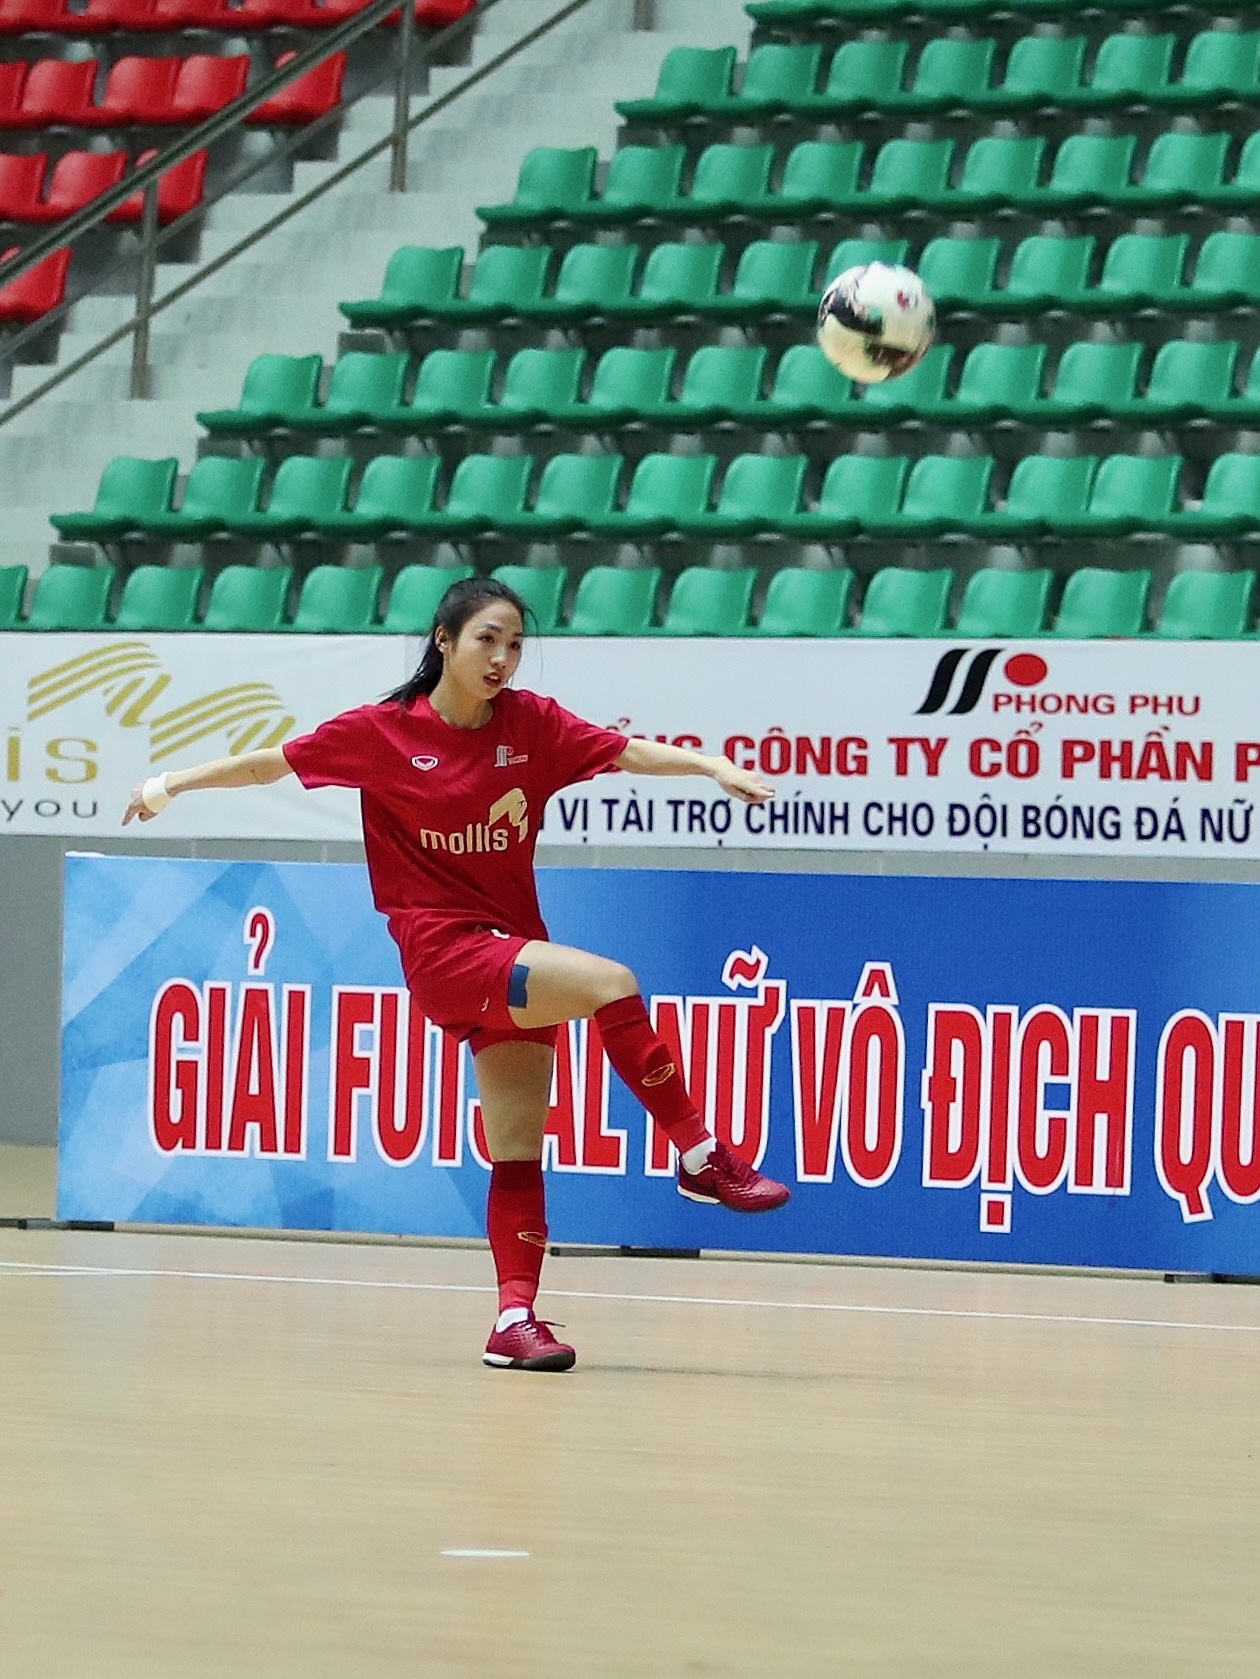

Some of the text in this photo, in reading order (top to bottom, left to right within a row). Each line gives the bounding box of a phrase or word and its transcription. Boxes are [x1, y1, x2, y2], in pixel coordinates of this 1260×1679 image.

[992, 693, 1201, 716] PHONG PHU
[724, 726, 869, 777] CÔNG
[888, 736, 949, 777] TY
[968, 721, 1041, 779] CỔ
[1061, 725, 1214, 782] PHẦN
[1, 798, 98, 822] you
[558, 797, 589, 844] VỊ
[601, 788, 654, 833] TÀI
[666, 797, 733, 847] TRỢ
[744, 790, 850, 836] CHÍNH
[863, 801, 934, 838] CHO
[947, 793, 1008, 850] ĐỘI
[1021, 795, 1121, 841] BÓNG
[1135, 794, 1187, 842] ĐÁ
[1200, 797, 1254, 843] NỮ
[420, 822, 509, 855] mollis
[147, 906, 312, 1161] GIẢI
[327, 984, 628, 1177] FUTAL
[790, 961, 906, 1188] VÔ
[921, 1002, 1137, 1233] ĐỊCH
